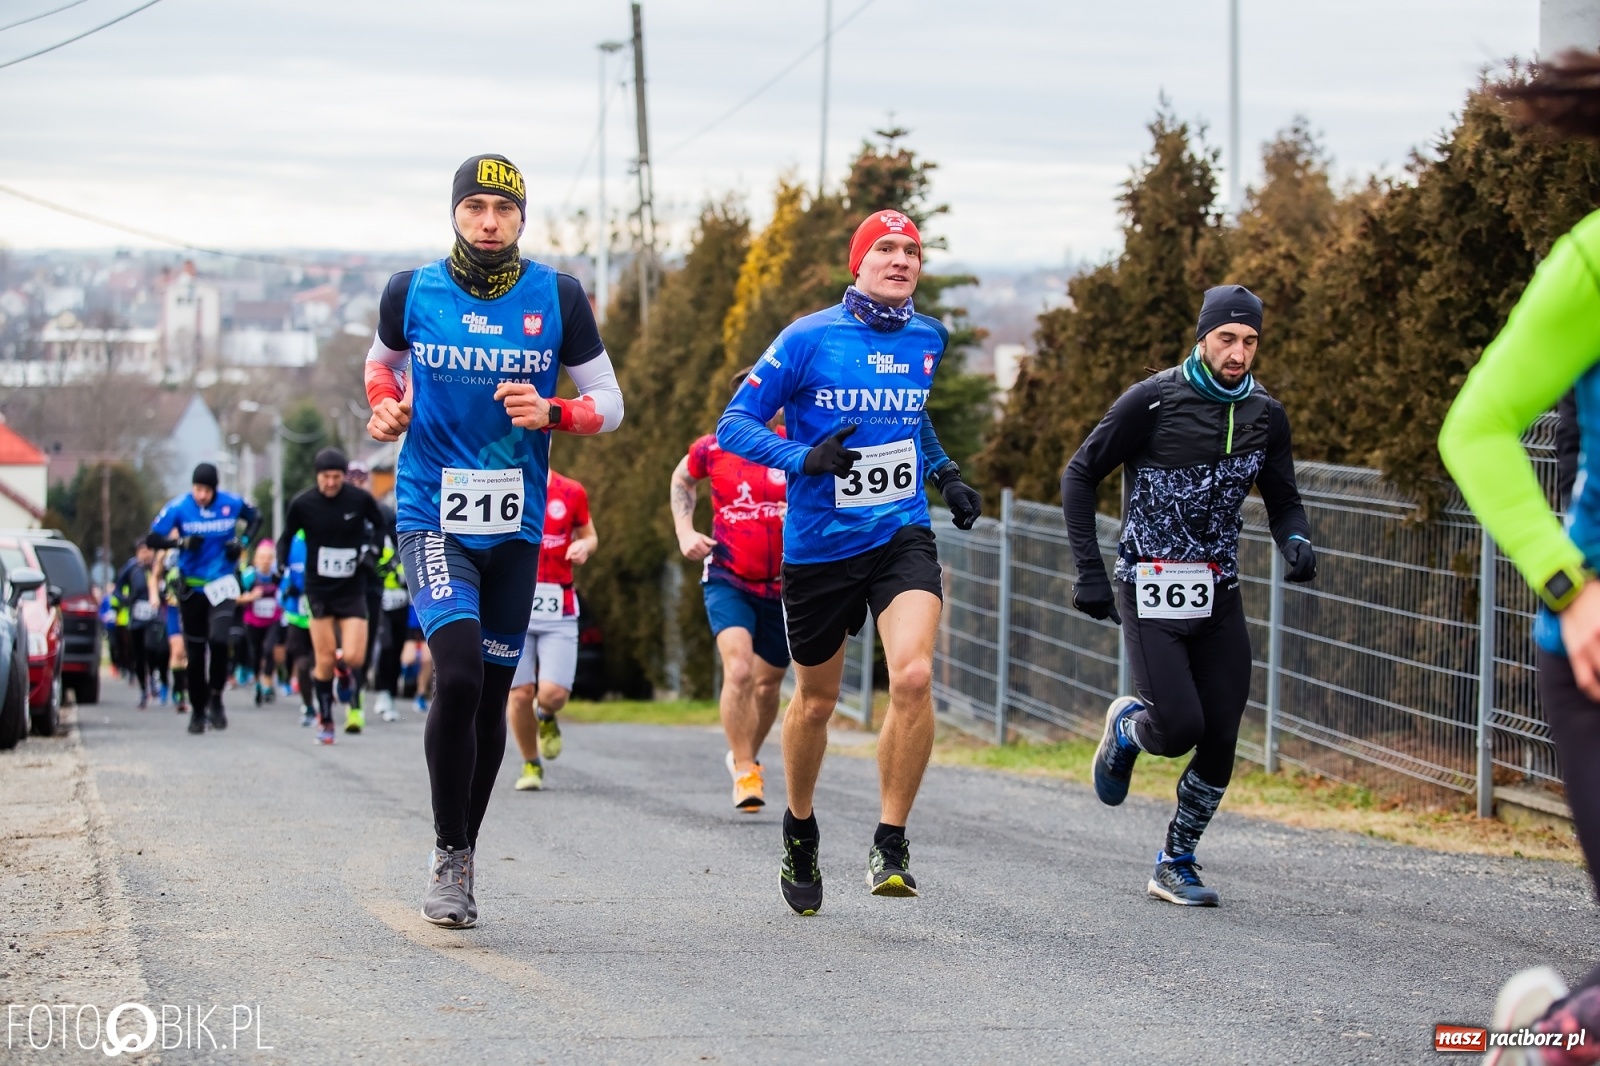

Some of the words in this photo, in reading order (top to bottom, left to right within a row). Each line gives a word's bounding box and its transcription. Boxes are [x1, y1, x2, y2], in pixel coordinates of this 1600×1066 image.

[412, 341, 553, 373] RUNNERS
[841, 462, 912, 496] 396
[446, 493, 519, 522] 216
[1142, 583, 1209, 608] 363
